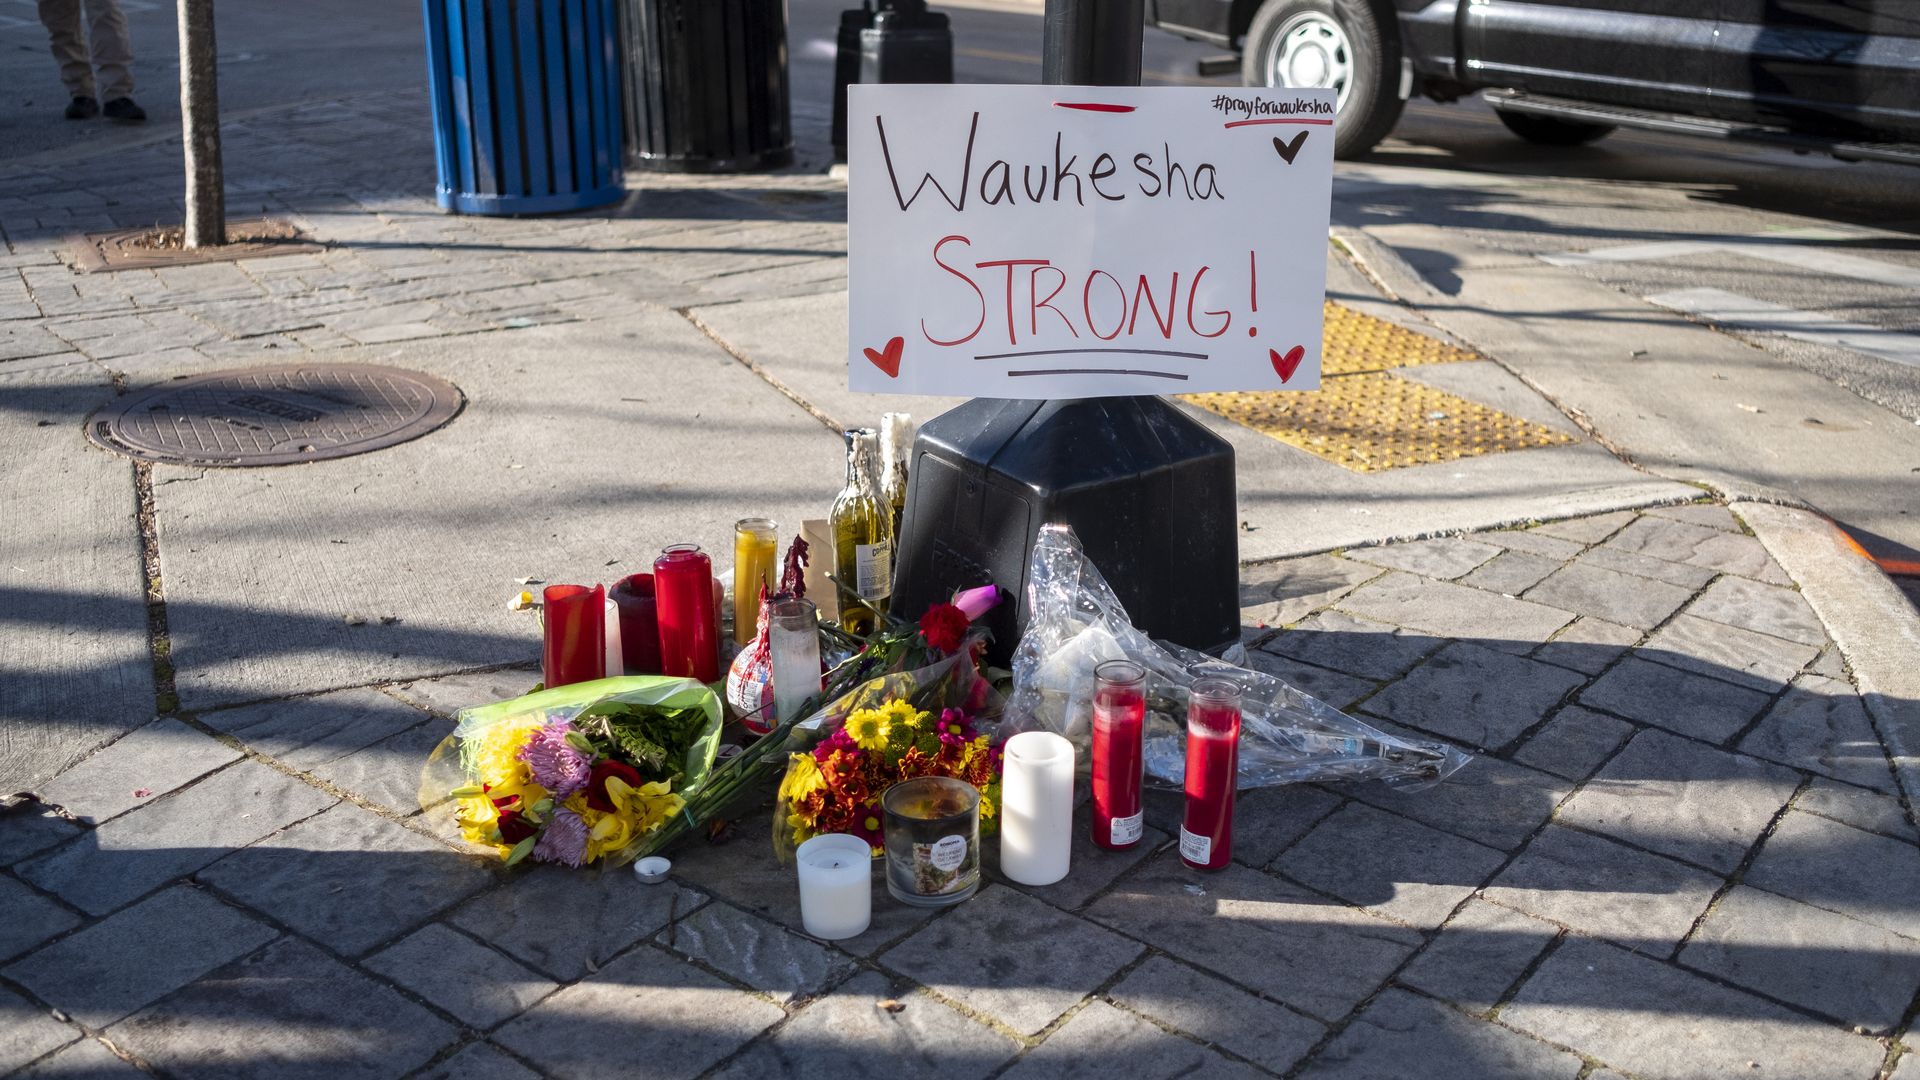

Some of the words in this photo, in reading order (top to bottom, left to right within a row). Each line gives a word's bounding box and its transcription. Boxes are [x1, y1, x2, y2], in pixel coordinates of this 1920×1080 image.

[1211, 94, 1334, 120] #prayforwaukesha
[876, 111, 1226, 212] Waukesha
[921, 235, 1258, 346] STRONG!
